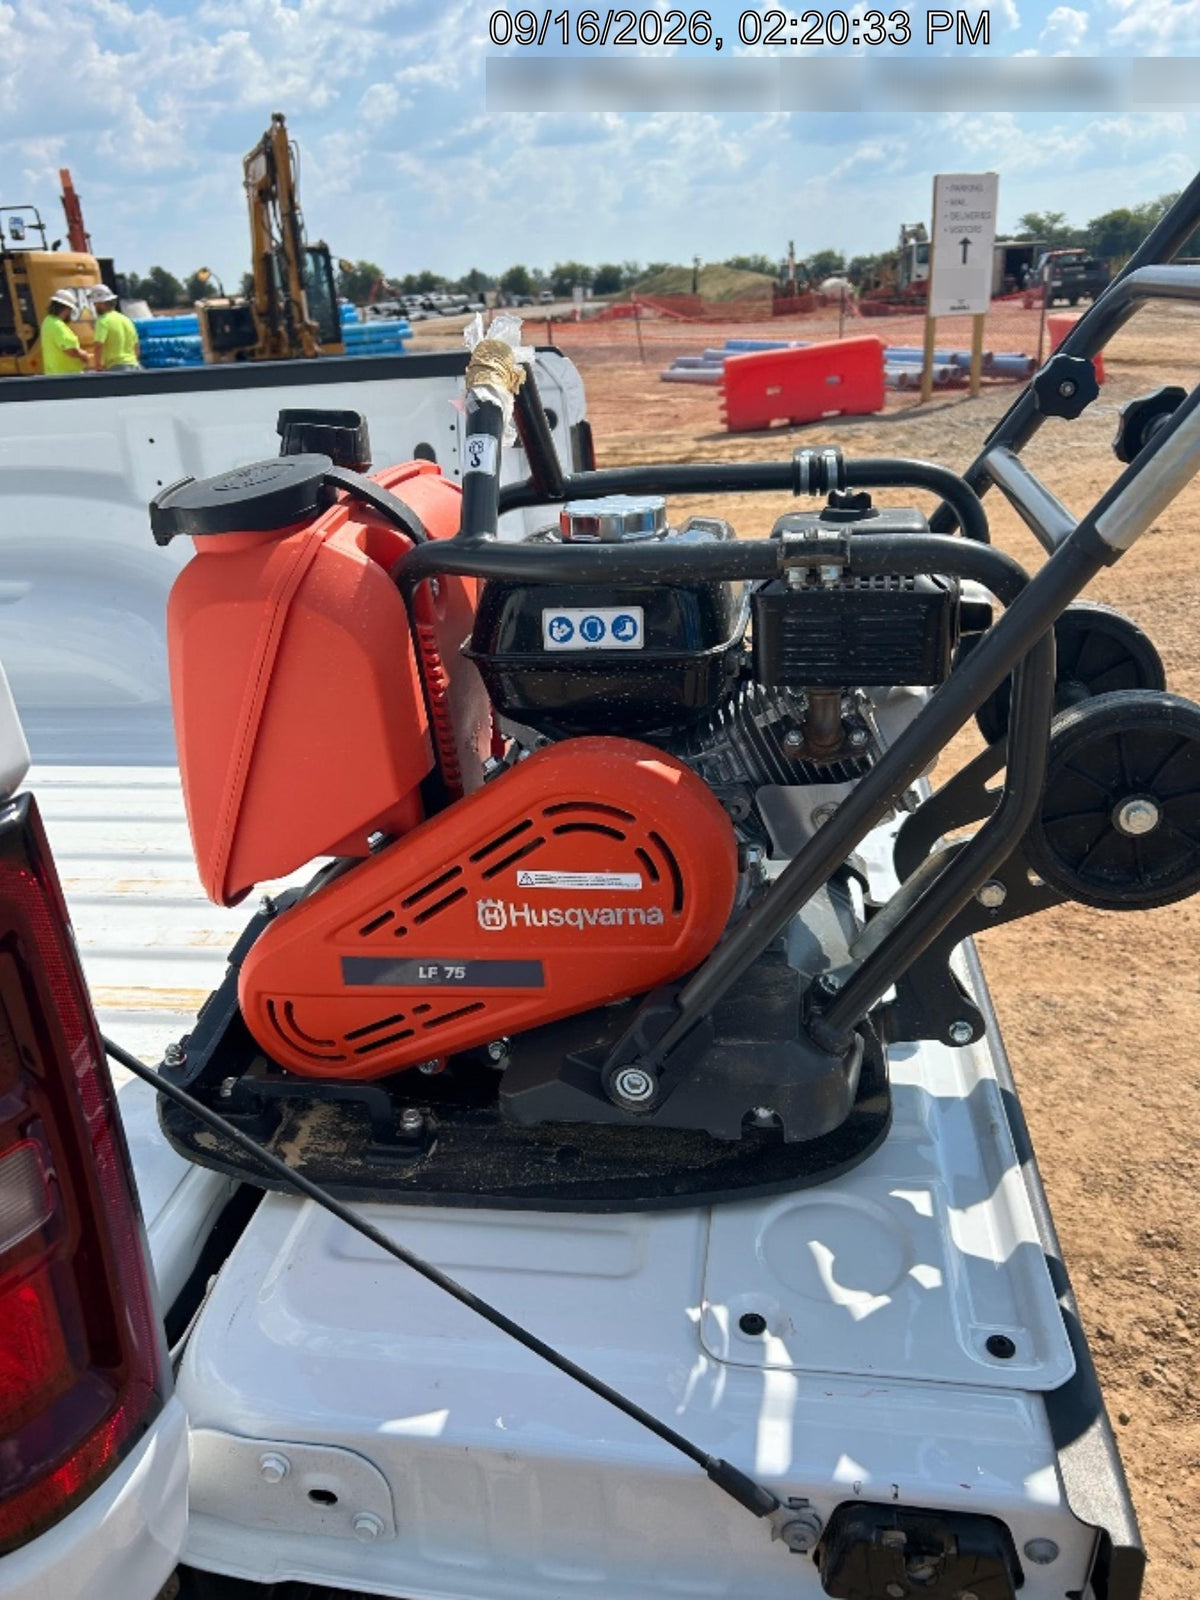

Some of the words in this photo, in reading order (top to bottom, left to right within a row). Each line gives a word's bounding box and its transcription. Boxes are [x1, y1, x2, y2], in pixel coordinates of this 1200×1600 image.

[509, 902, 664, 930] Husqvarna
[418, 966, 438, 979] LF
[443, 966, 466, 979] 75
